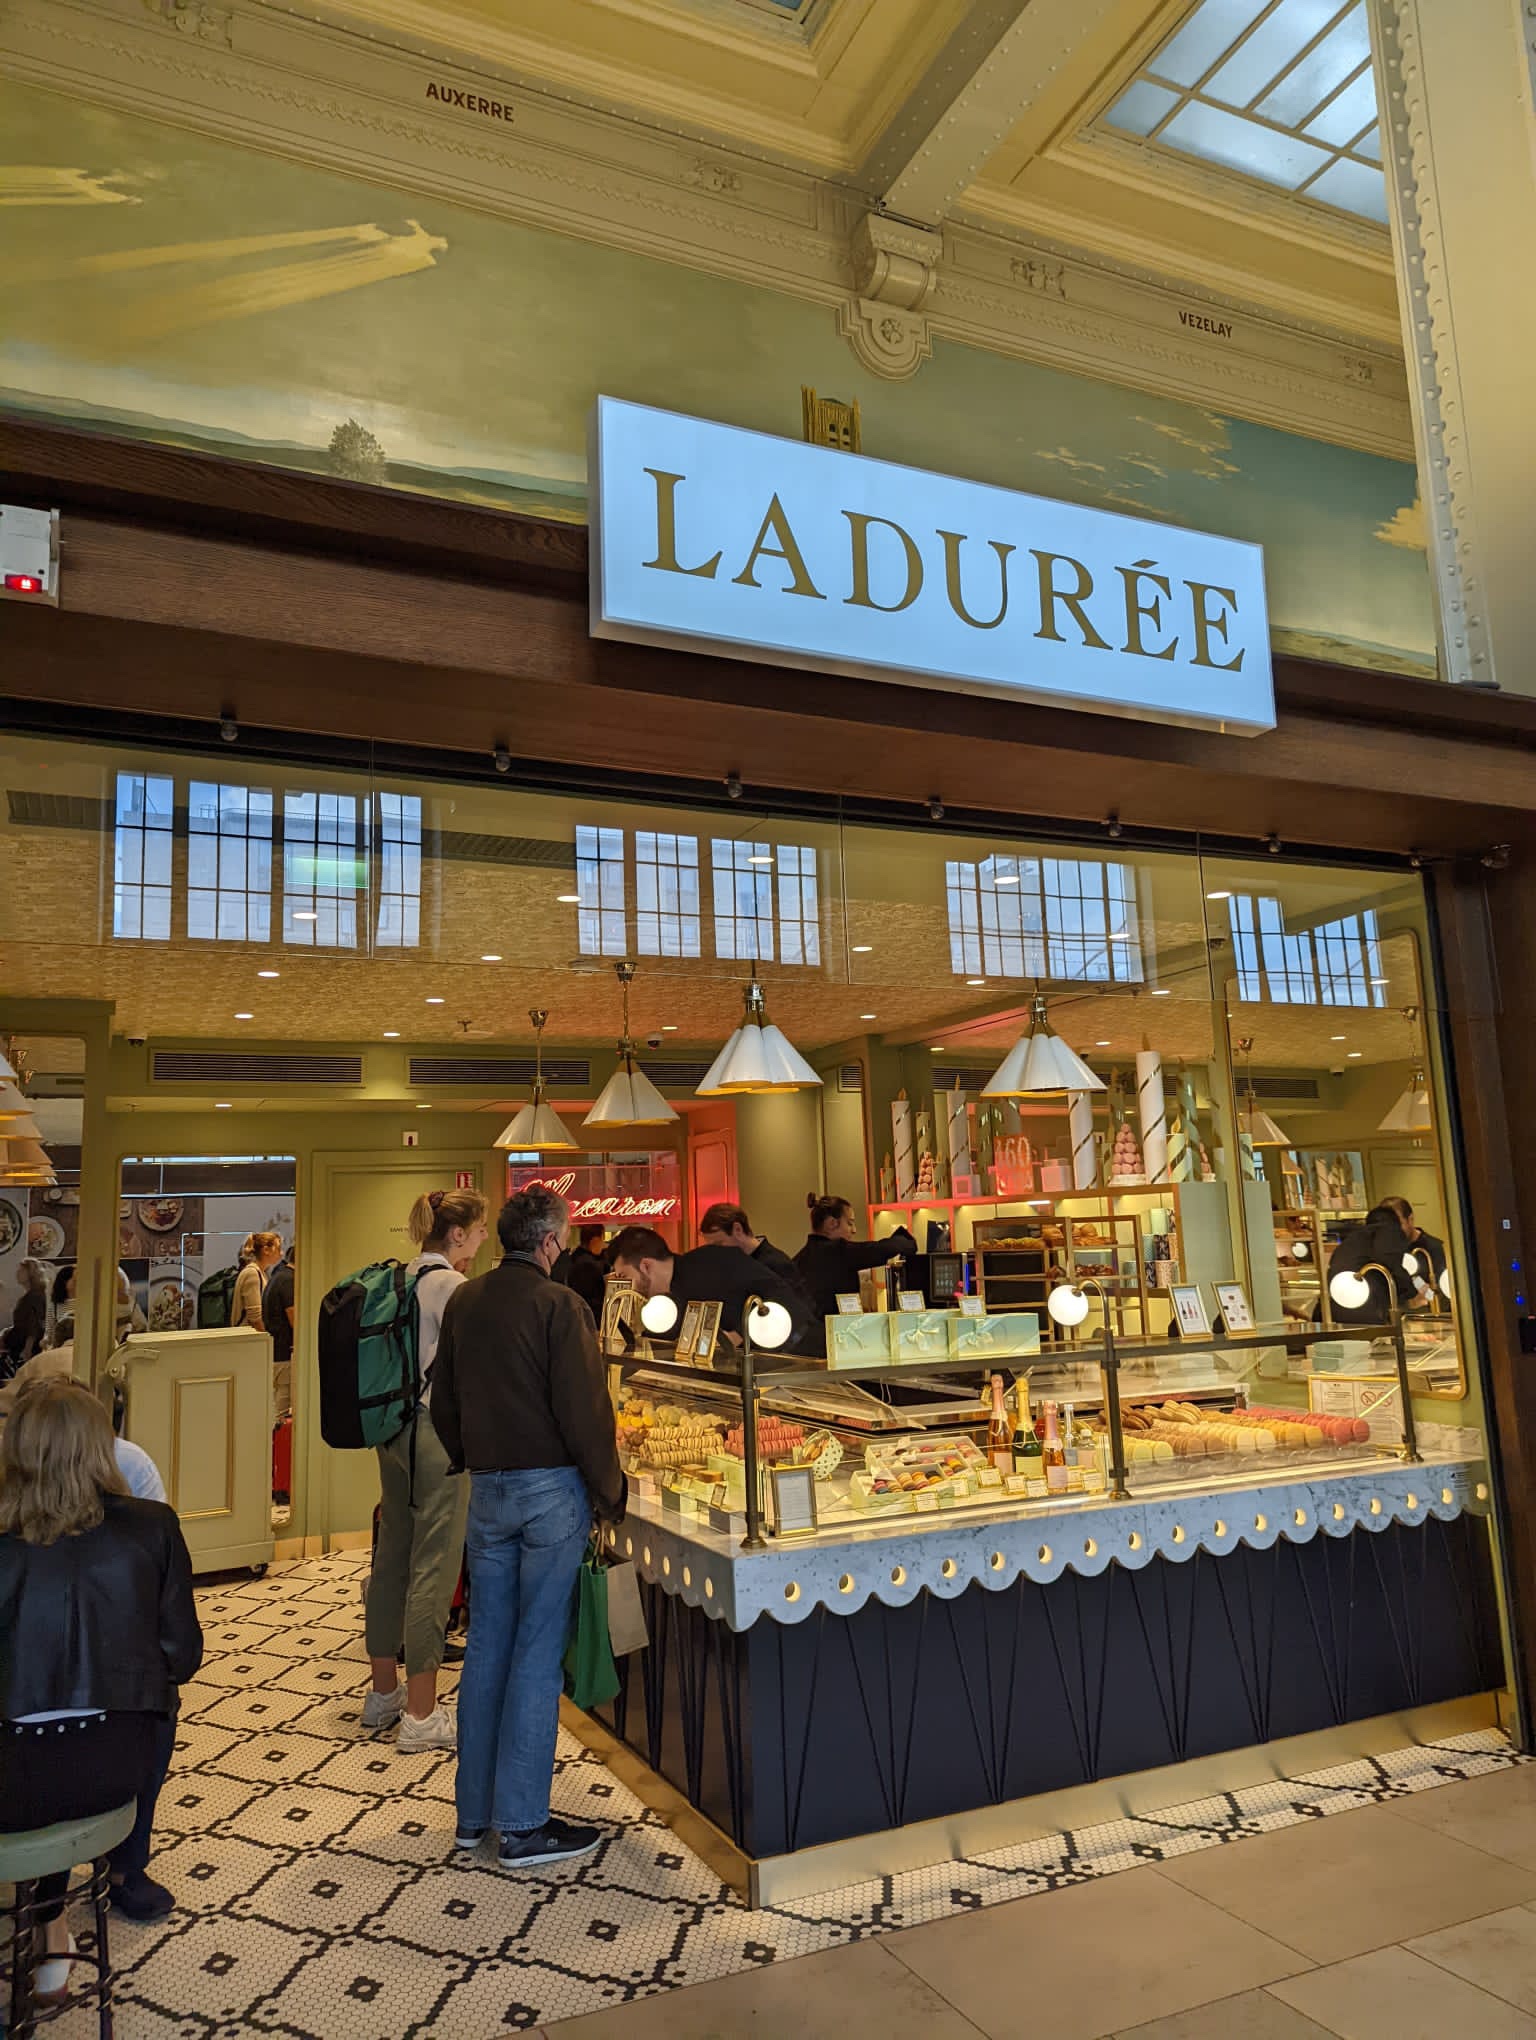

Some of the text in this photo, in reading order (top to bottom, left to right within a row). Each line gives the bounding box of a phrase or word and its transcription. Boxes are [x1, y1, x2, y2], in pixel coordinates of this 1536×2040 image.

[426, 82, 514, 123] AUXERRE
[1178, 311, 1232, 339] VEZELAY
[642, 467, 1247, 673] LADURÉE
